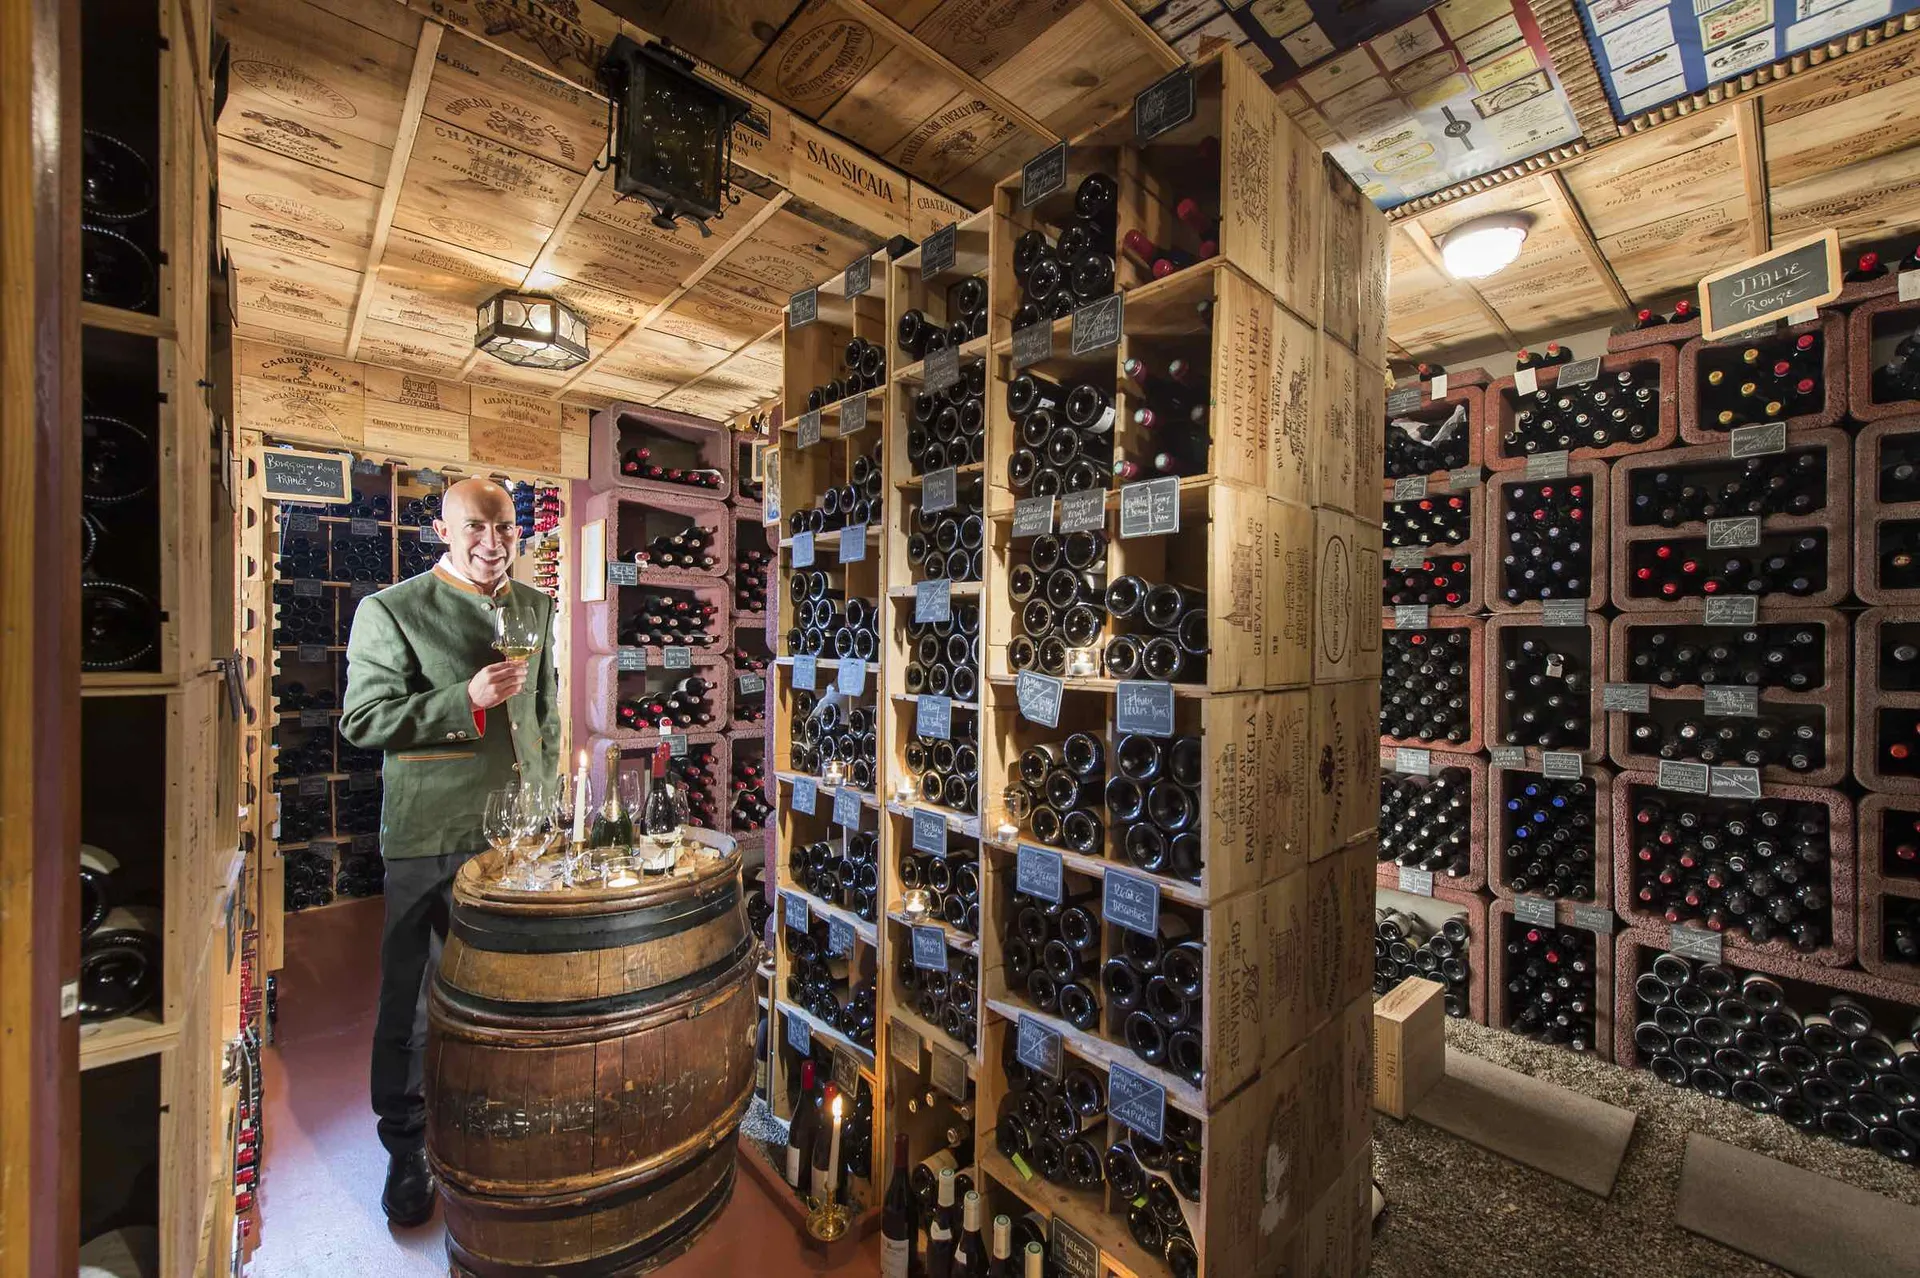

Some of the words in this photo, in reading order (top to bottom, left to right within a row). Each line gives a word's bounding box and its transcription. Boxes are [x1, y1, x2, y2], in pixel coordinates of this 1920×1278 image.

[501, 102, 542, 123] PAPE
[806, 140, 895, 203] SASSICAIA
[917, 197, 957, 217] CHATEAU
[262, 357, 347, 383] CARBONNIEUX
[1232, 316, 1245, 437] FONTESTEAU
[1247, 308, 1260, 395] SAUVEUR
[319, 382, 346, 393] GRAVES
[1246, 399, 1255, 458] SAINT
[1259, 392, 1268, 450] MEDOC
[1254, 522, 1262, 656] CHEVAL-BLANC
[1247, 713, 1256, 776] SEGLA
[1238, 754, 1246, 825] CHATEAU
[1247, 785, 1255, 863] RAUSAN
